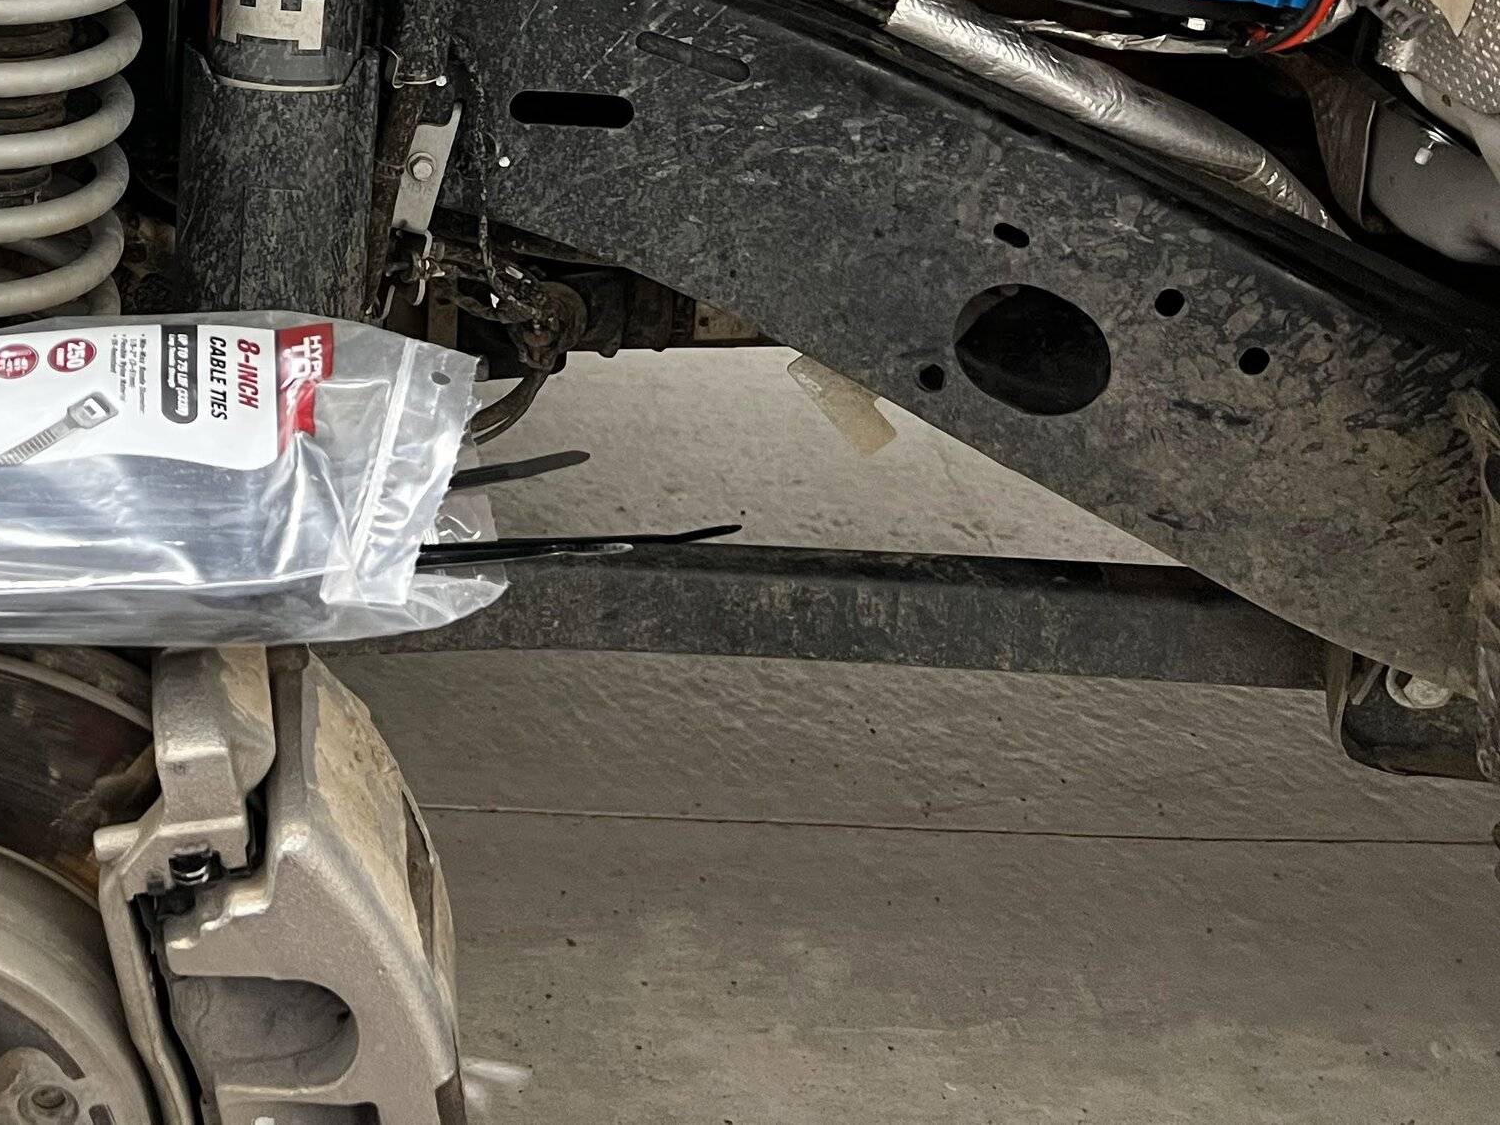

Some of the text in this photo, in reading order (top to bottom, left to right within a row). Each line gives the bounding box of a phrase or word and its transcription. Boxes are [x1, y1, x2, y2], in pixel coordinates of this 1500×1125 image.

[65, 341, 85, 369] 250
[209, 336, 228, 420] CABLE TIES
[237, 338, 261, 409] 8-INCH
